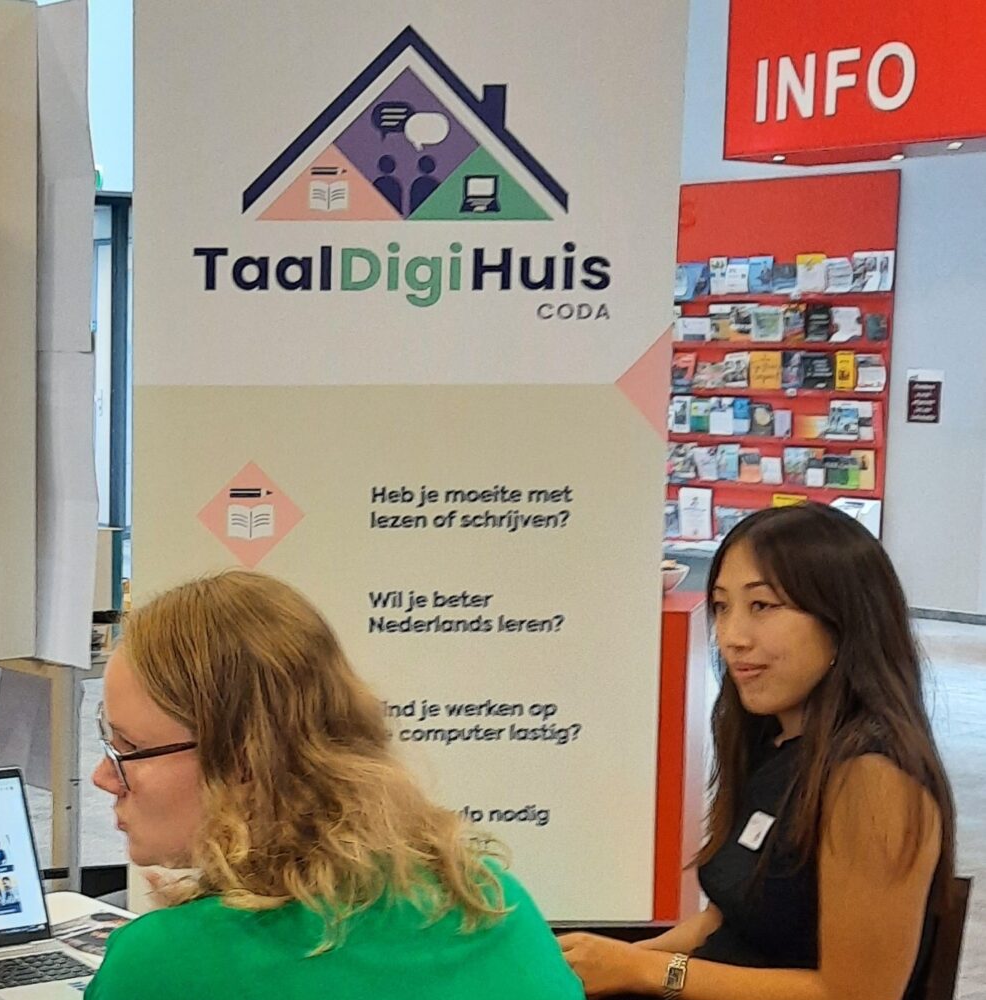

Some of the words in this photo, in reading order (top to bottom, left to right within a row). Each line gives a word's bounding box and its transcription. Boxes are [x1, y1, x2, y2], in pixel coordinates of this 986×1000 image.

[754, 41, 916, 123] INFO
[193, 241, 611, 307] TaalDigiHuis
[537, 303, 611, 320] CODA
[371, 486, 414, 503] Heb
[416, 485, 439, 508] je
[444, 485, 522, 503] moeite
[527, 486, 573, 503] met
[370, 511, 427, 528] lezen
[432, 510, 457, 528] of
[460, 510, 571, 532] schrijven?
[368, 591, 402, 608] Wil
[404, 590, 428, 612] je
[432, 590, 494, 608] beter
[368, 615, 492, 633] Nederlands
[497, 614, 565, 633] leren?
[382, 699, 415, 717] ind
[418, 699, 440, 721] je
[445, 699, 524, 717] werken
[529, 703, 558, 720] op
[400, 724, 505, 745] computer
[509, 723, 581, 745] lastig?
[489, 804, 550, 827] nodig
